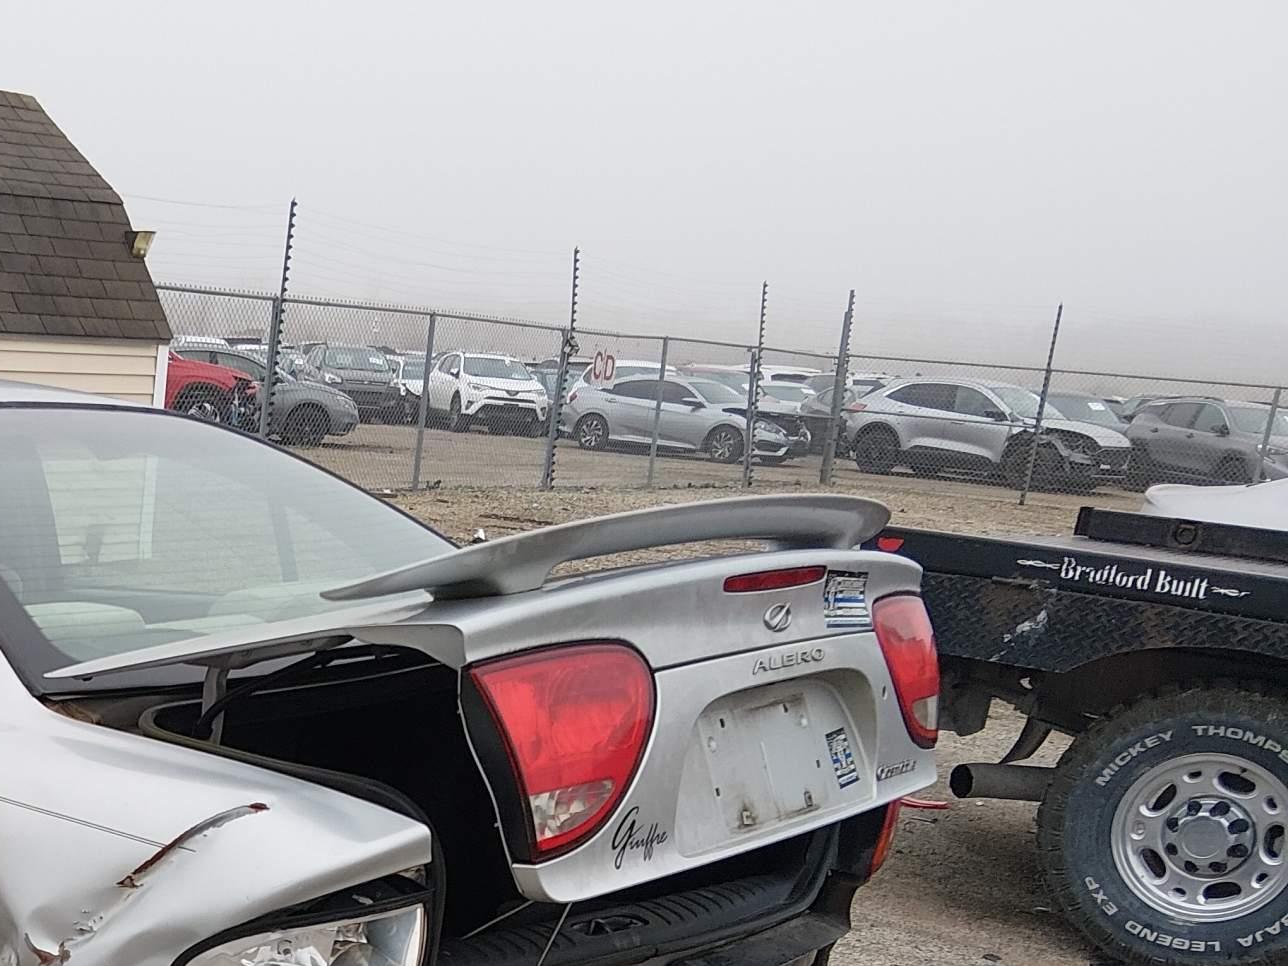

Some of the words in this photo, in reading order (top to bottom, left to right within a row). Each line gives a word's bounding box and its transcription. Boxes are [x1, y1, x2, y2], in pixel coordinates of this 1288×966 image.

[1061, 557, 1152, 590] Bradford
[1155, 570, 1209, 599] Built
[752, 648, 825, 675] ALERO
[1095, 730, 1174, 786] MICKEY
[1085, 876, 1118, 916] EXP
[1125, 920, 1221, 952] LEGEND
